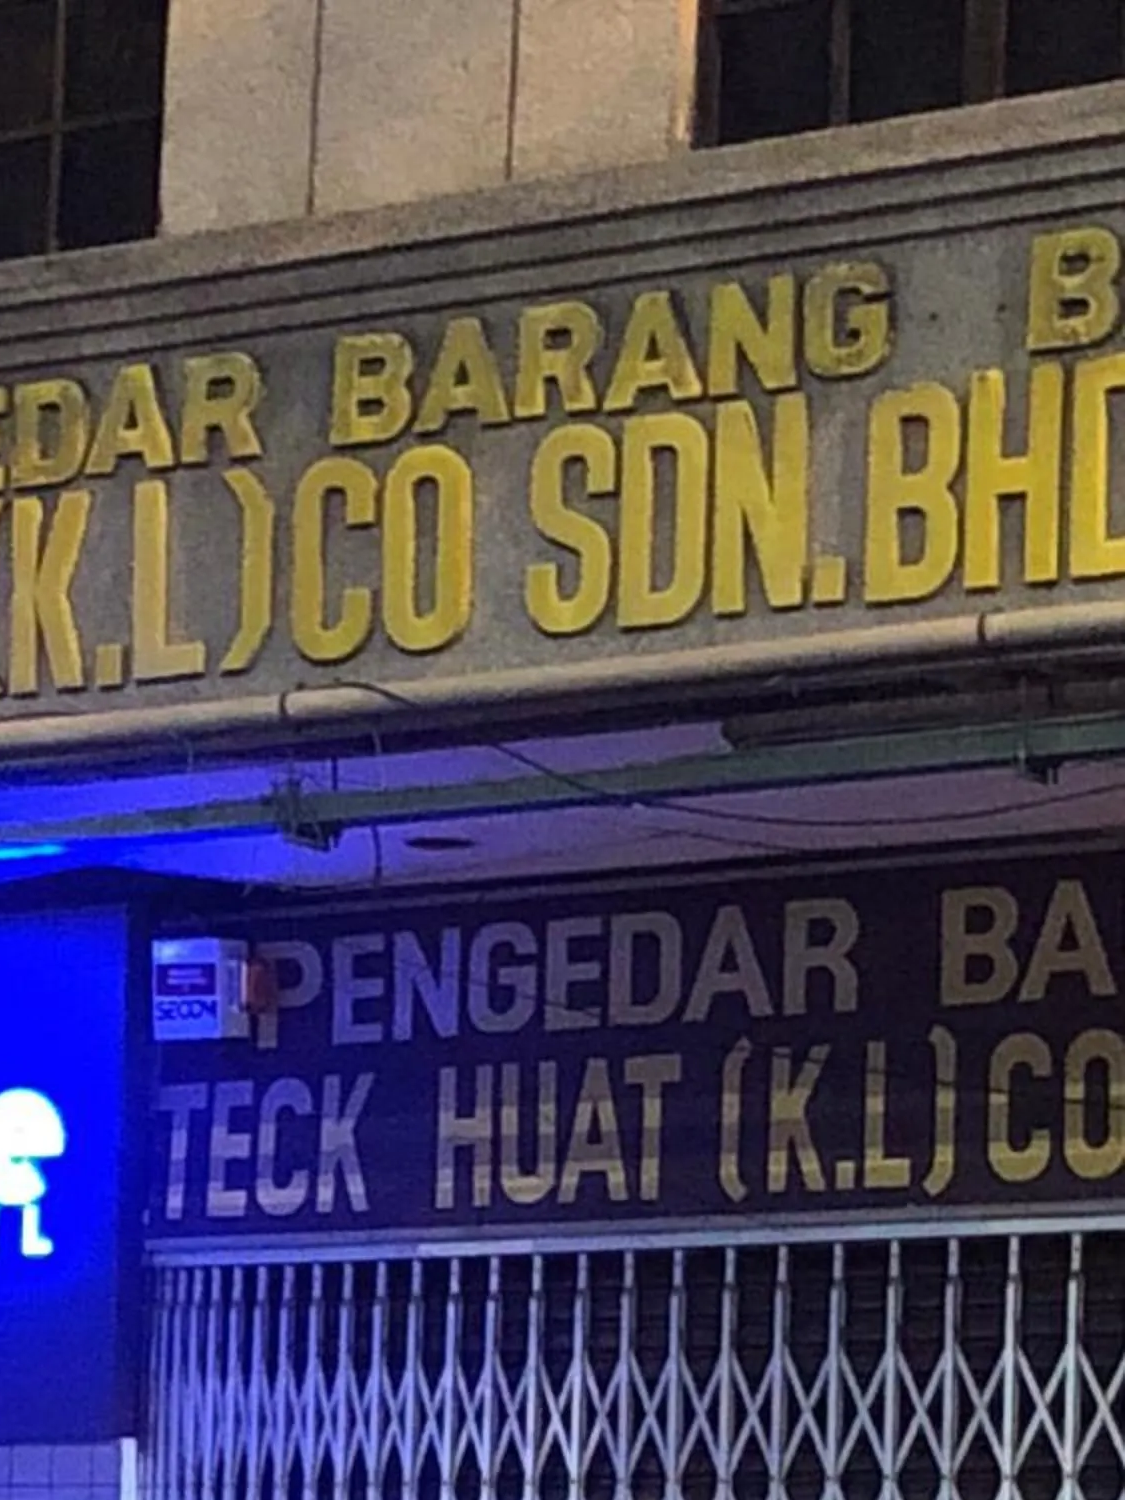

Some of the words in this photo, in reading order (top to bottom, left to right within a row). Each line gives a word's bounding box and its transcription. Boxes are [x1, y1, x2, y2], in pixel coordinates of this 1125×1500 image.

[330, 261, 890, 445] BARANG
[254, 898, 859, 1049] PENGEDAR
[940, 880, 1117, 1006] BA
[154, 1072, 374, 1220] TECK
[434, 1054, 682, 1209] HUAT
